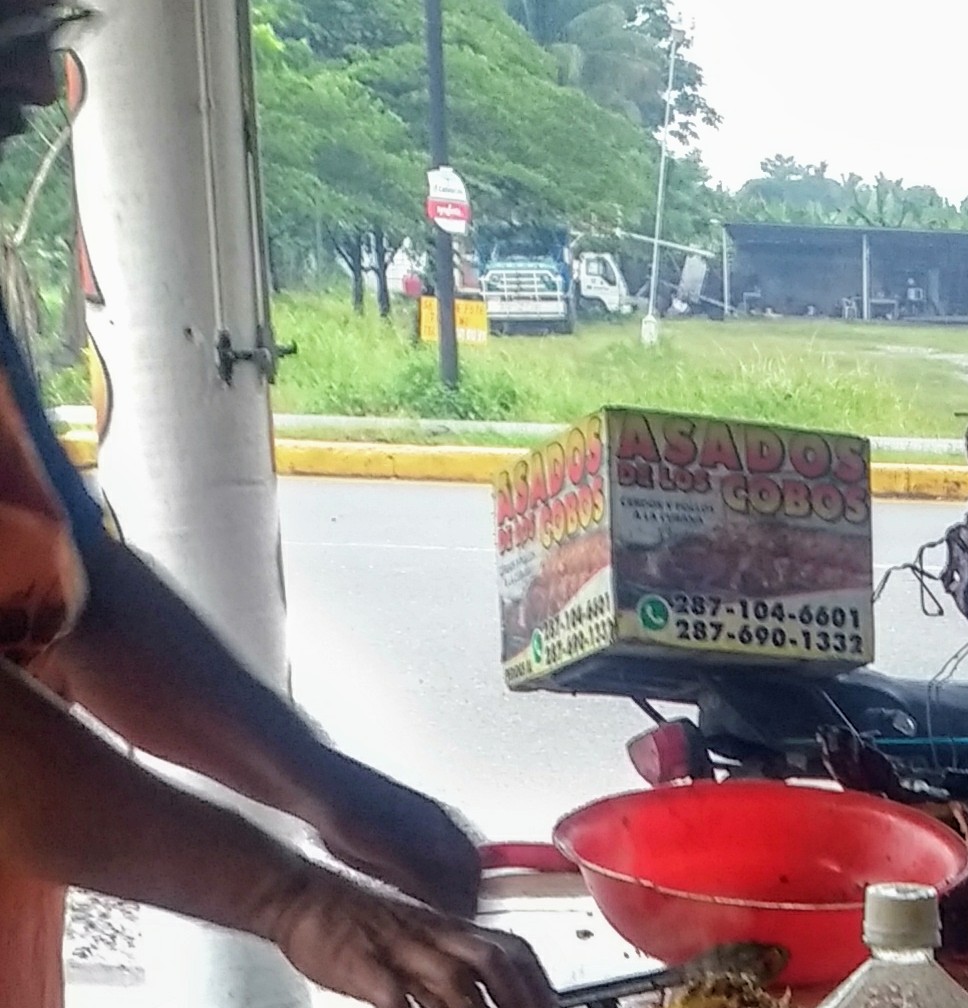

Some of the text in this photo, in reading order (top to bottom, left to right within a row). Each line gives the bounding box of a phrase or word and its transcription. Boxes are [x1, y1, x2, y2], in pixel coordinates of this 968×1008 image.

[497, 416, 602, 526] ASADOS
[616, 415, 868, 484] ASADOS
[618, 463, 713, 493] DE LOS
[720, 473, 871, 524] COBOS
[540, 475, 605, 549] COBOS
[674, 595, 862, 629] 287-104-6601
[676, 618, 863, 653] 287-690-1332
